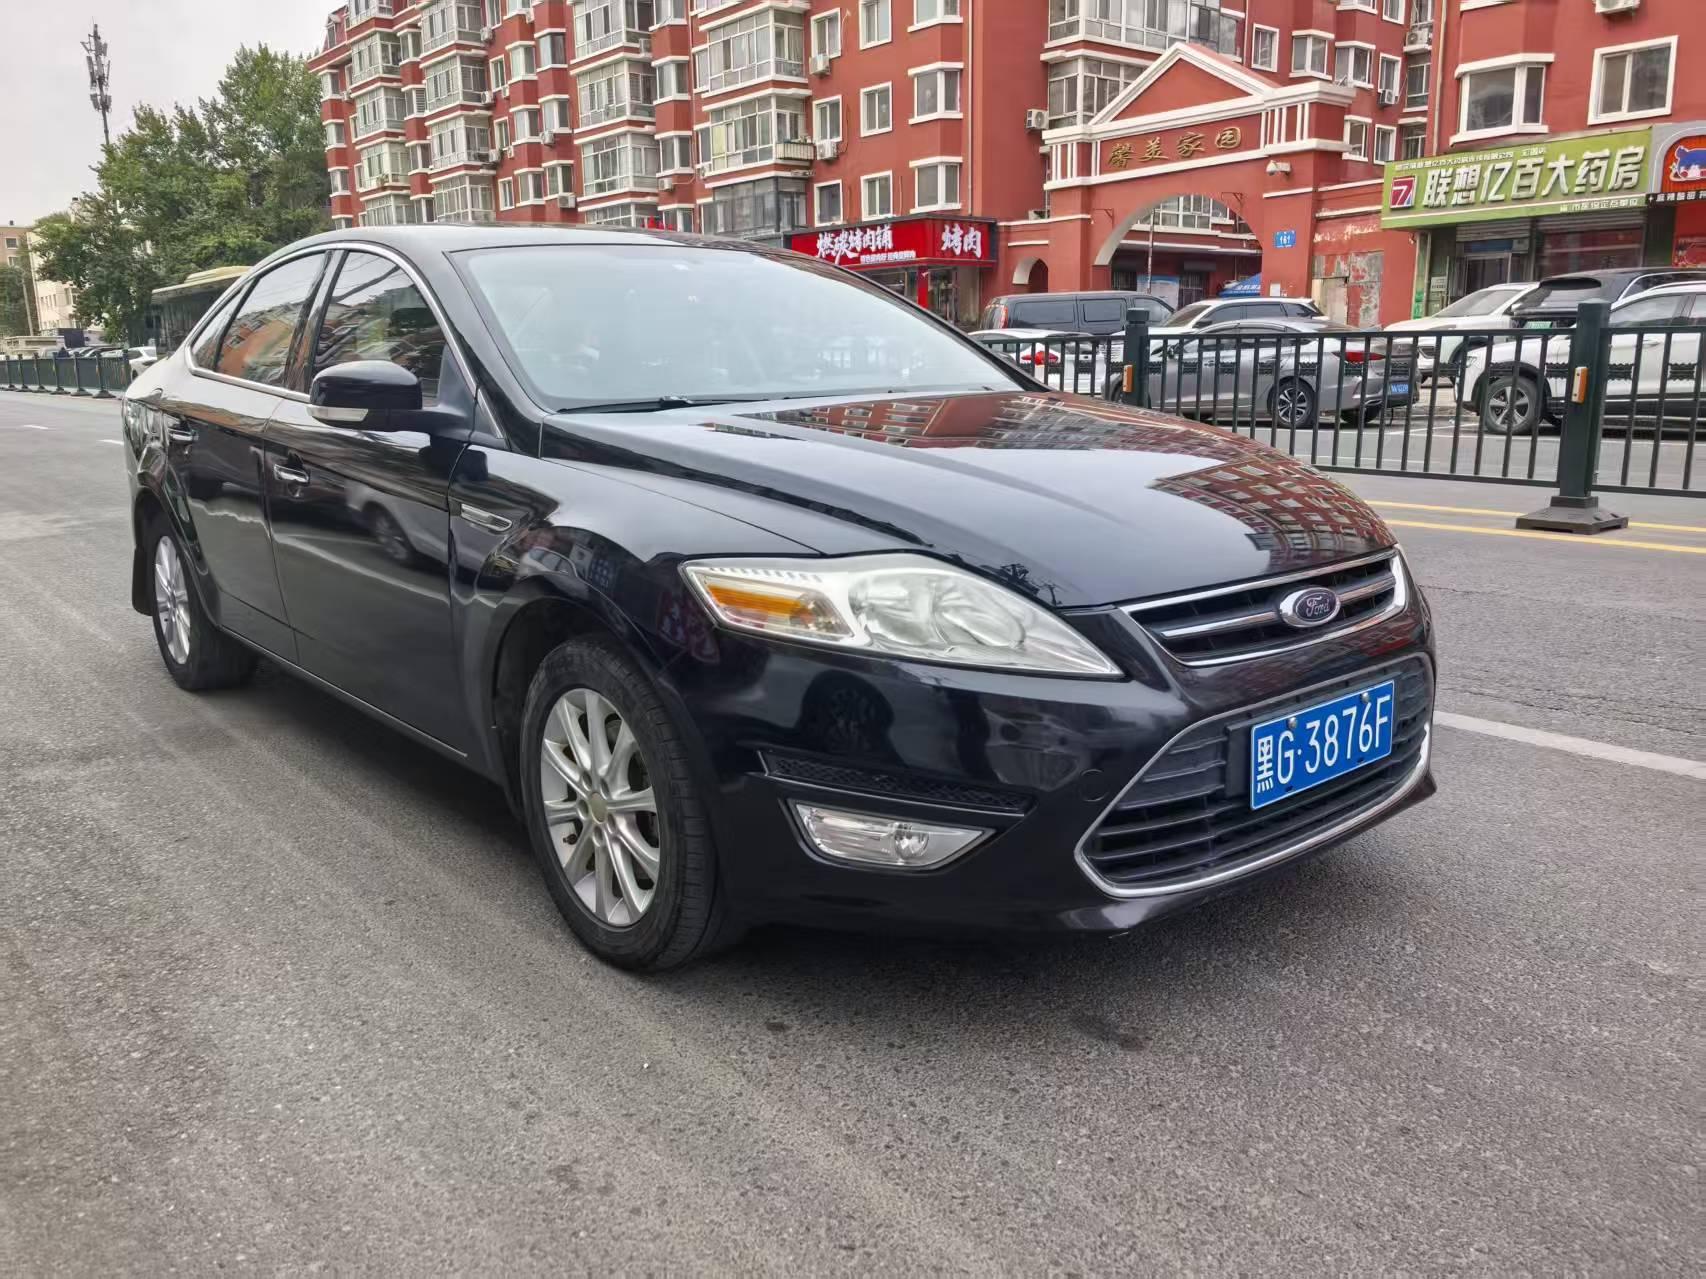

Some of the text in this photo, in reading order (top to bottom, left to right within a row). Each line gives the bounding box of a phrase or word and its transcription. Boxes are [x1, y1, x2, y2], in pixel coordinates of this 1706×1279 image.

[1107, 125, 1243, 169] 馨美家园
[1422, 144, 1646, 209] 联想亿百大药房
[941, 224, 982, 259] 烤肉
[1306, 596, 1330, 616] Ford
